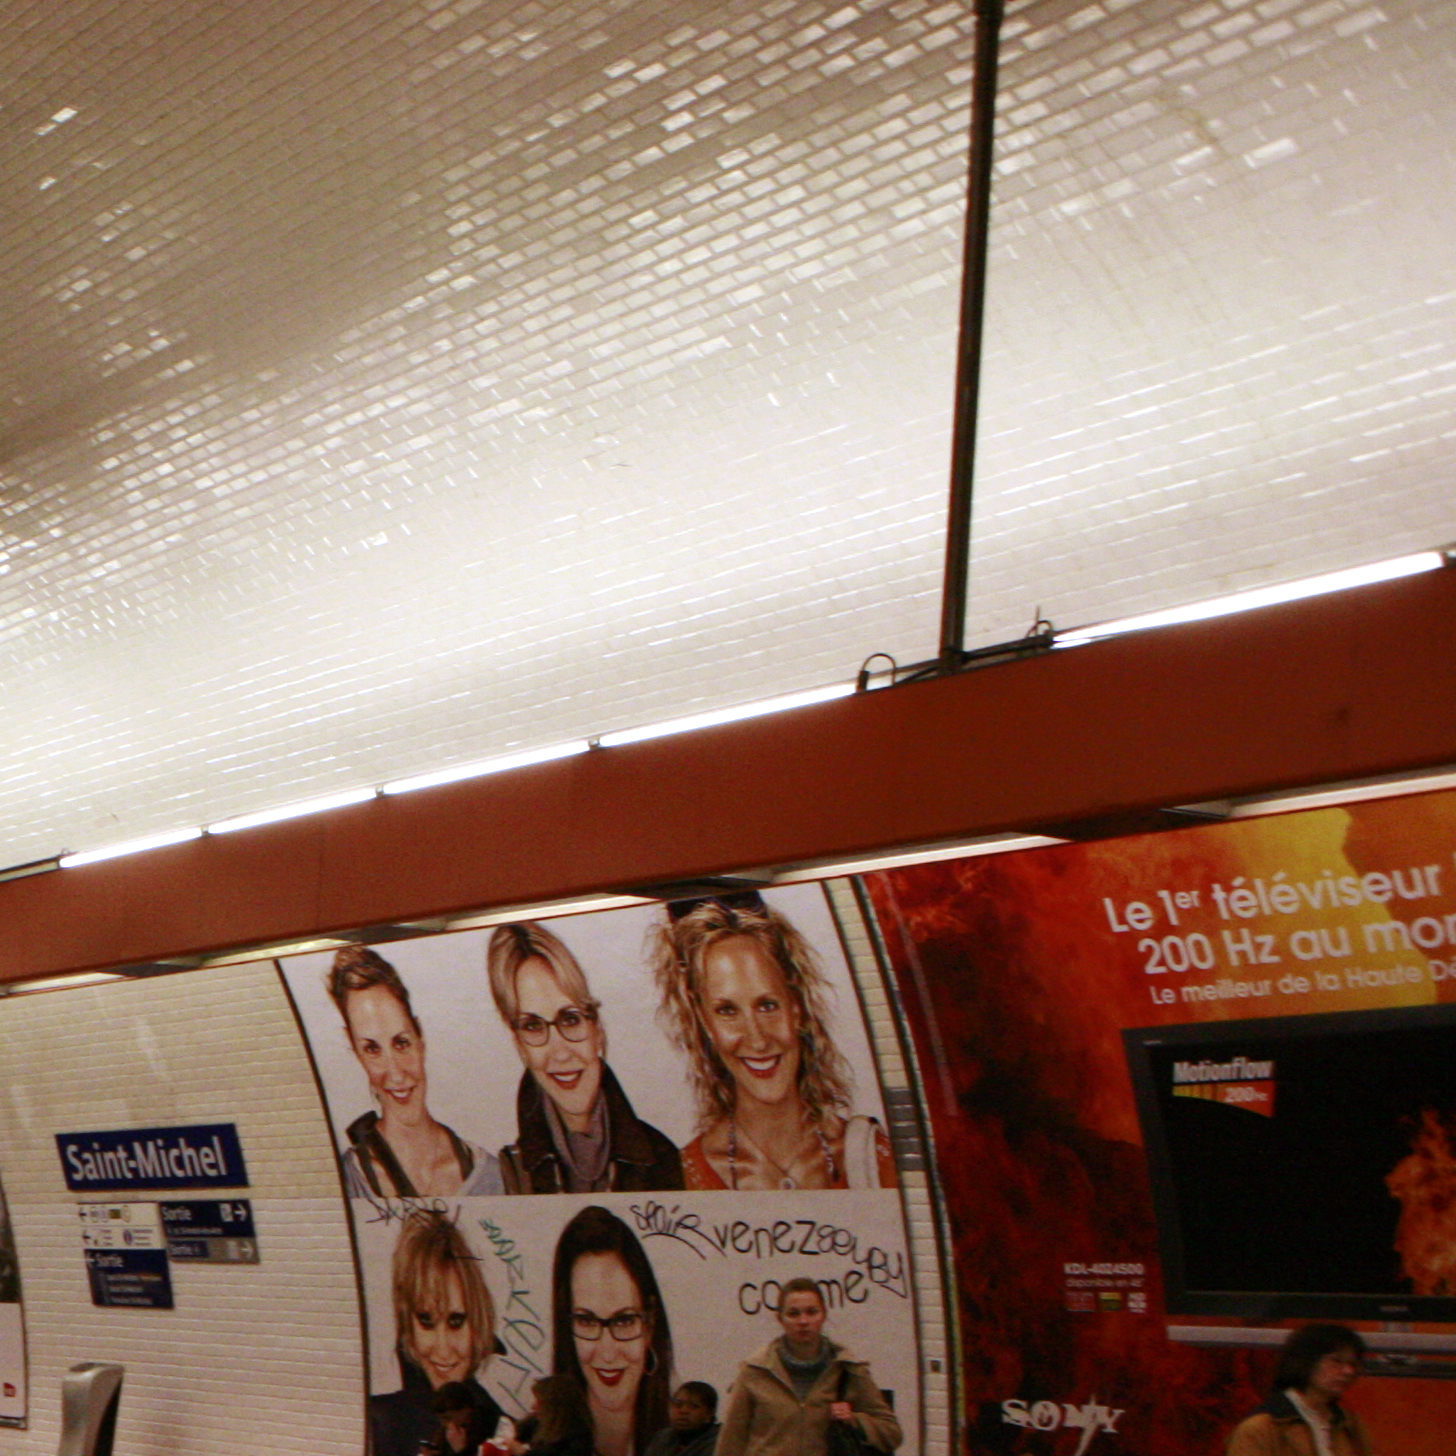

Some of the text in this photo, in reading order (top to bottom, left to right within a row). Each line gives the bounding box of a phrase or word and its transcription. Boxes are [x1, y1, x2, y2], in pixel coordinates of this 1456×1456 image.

[1103, 897, 1153, 933] Le
[1211, 864, 1442, 921] téléviseur
[1137, 932, 1215, 975] 200
[1220, 928, 1281, 967] Hz
[1290, 925, 1352, 961] au
[1150, 957, 1456, 1005] Le meilleur de la Haute Dé
[67, 1136, 228, 1182] Saint-Michel
[1002, 1399, 1126, 1434] SONY
